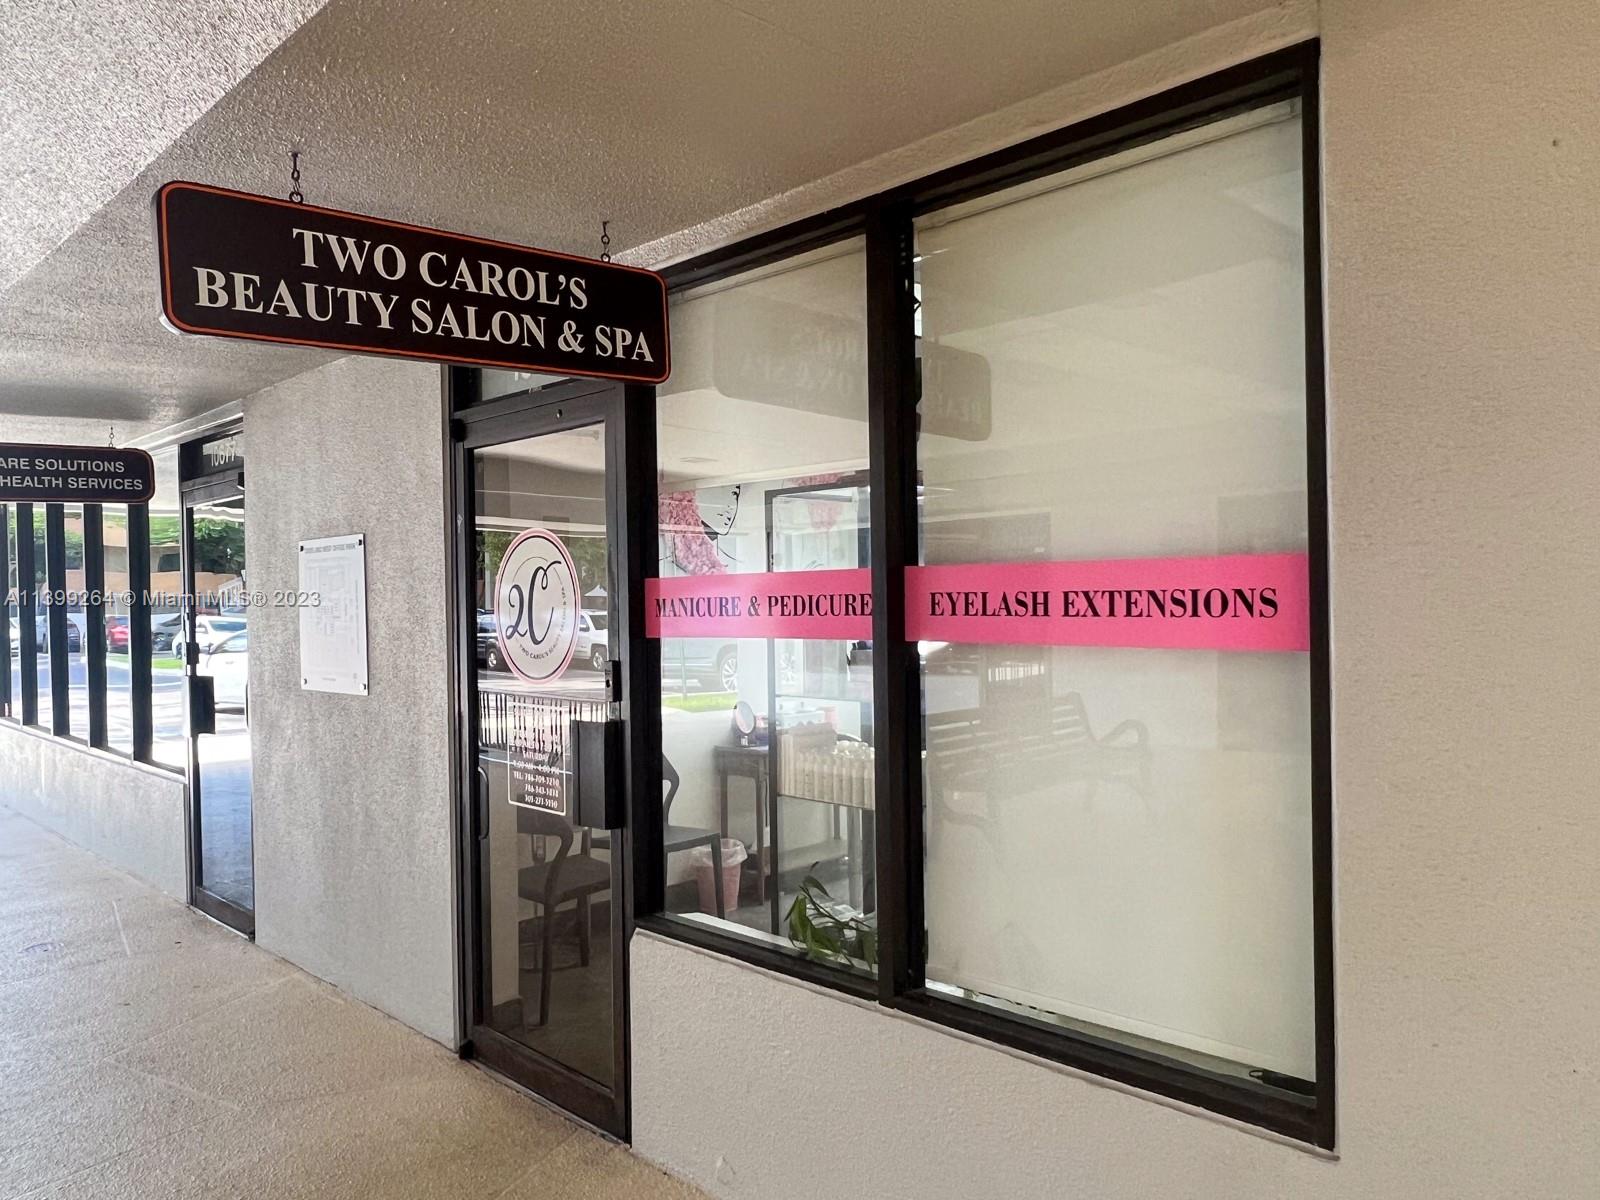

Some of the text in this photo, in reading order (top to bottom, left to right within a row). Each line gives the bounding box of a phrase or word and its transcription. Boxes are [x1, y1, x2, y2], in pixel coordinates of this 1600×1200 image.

[292, 228, 588, 310] TWO CAROL'S
[192, 266, 655, 363] BEAUTY SALON & SPA
[35, 458, 125, 473] SOLUTIONS
[0, 475, 143, 490] HEALTH SERVICES
[655, 593, 873, 617] MANICURE & PEDICURE
[929, 587, 1279, 618] EYELASH EXTENSIONS
